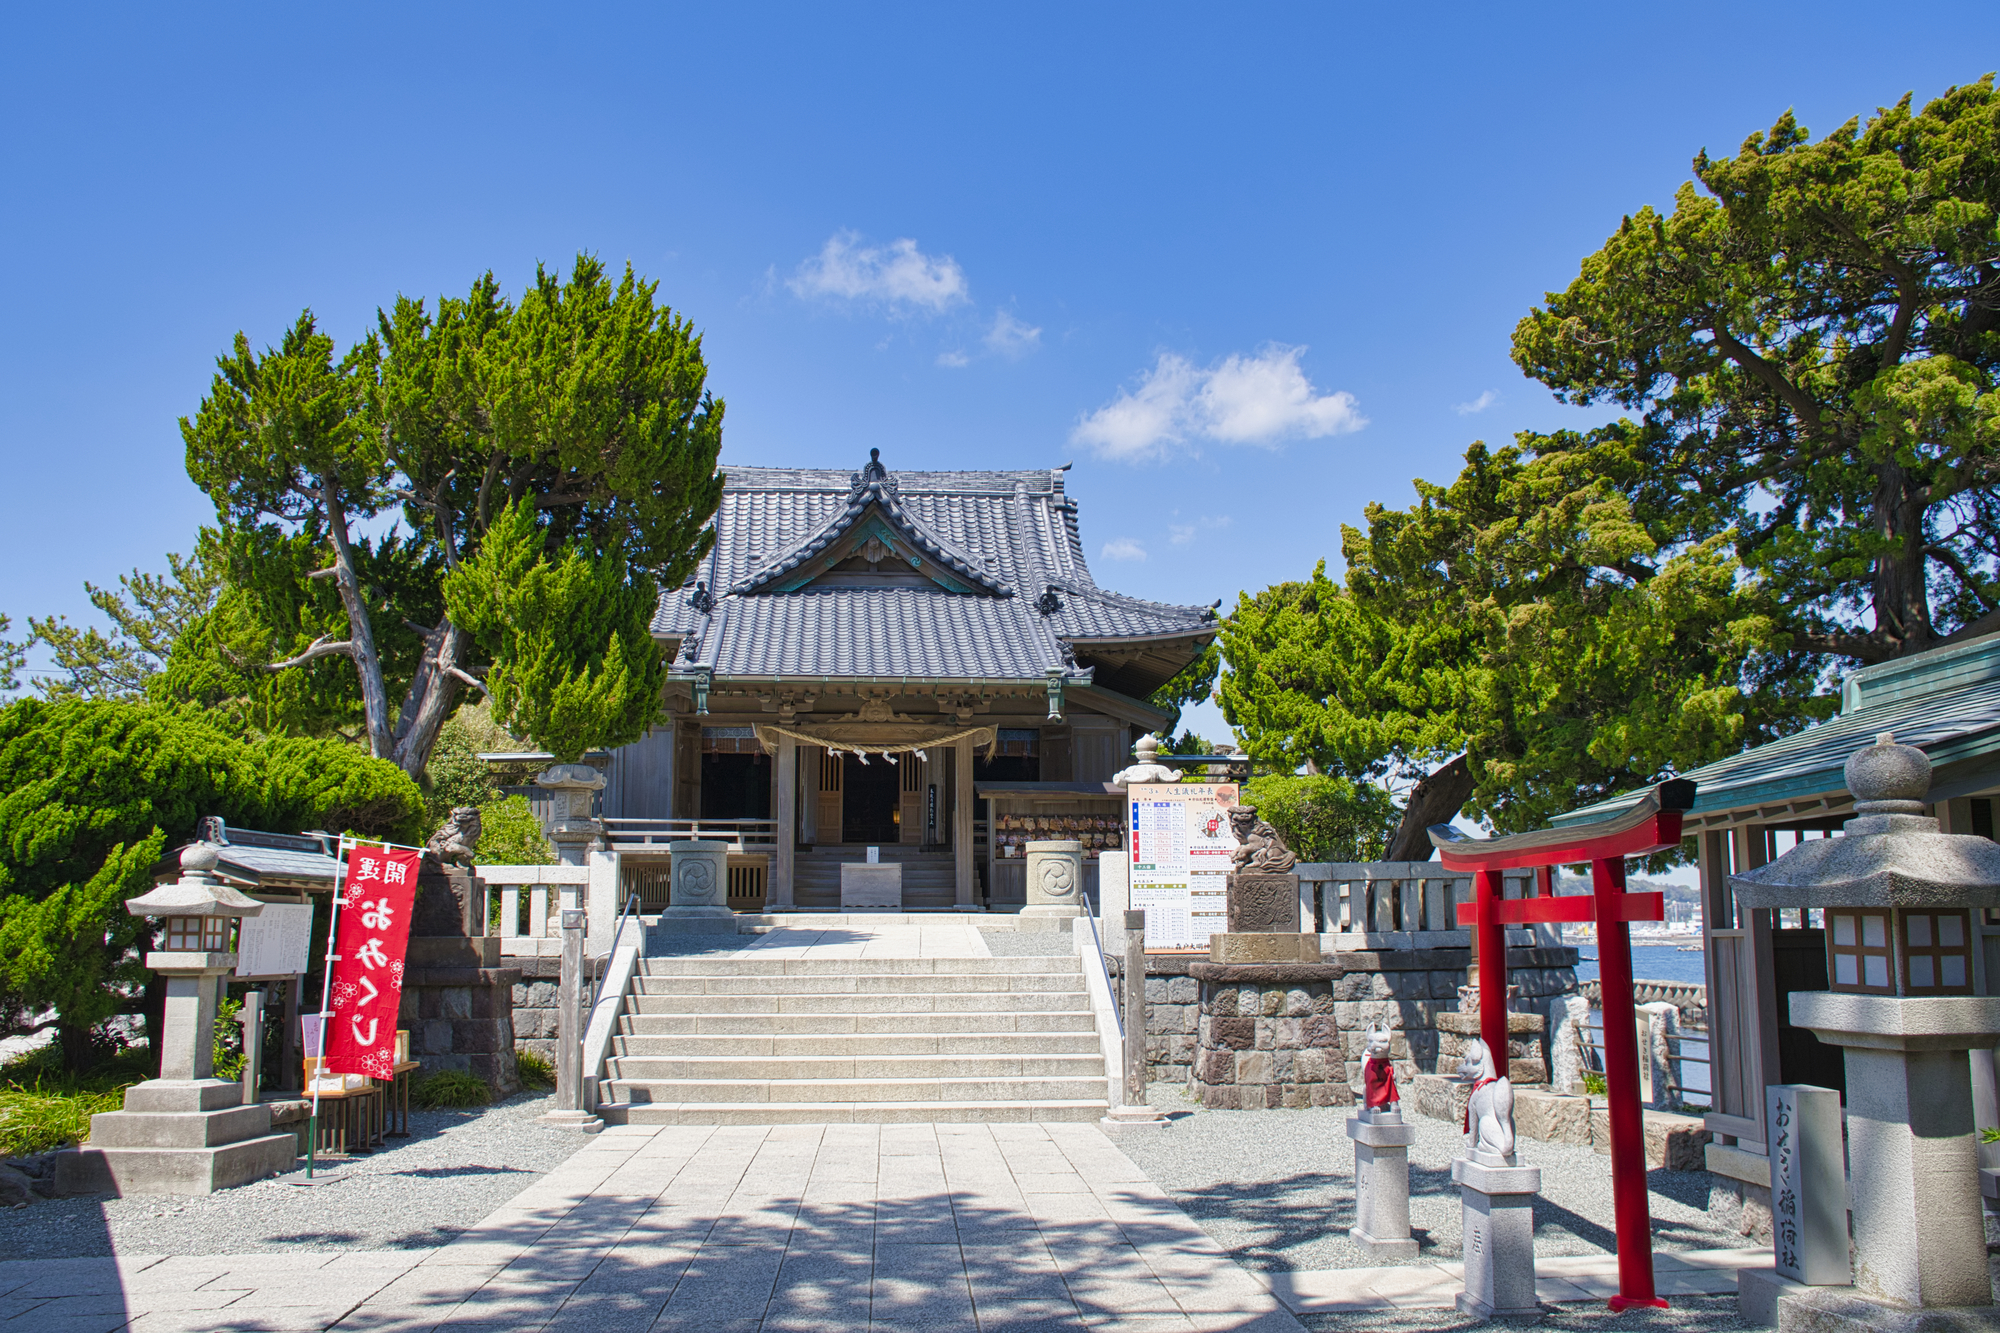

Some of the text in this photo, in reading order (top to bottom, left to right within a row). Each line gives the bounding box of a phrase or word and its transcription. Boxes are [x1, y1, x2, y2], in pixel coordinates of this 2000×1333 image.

[1165, 787, 1214, 795] 人生儀礼年表
[1641, 1029, 1651, 1082] おせき稲荷社
[1775, 1096, 1800, 1271] おせき稲荷社
